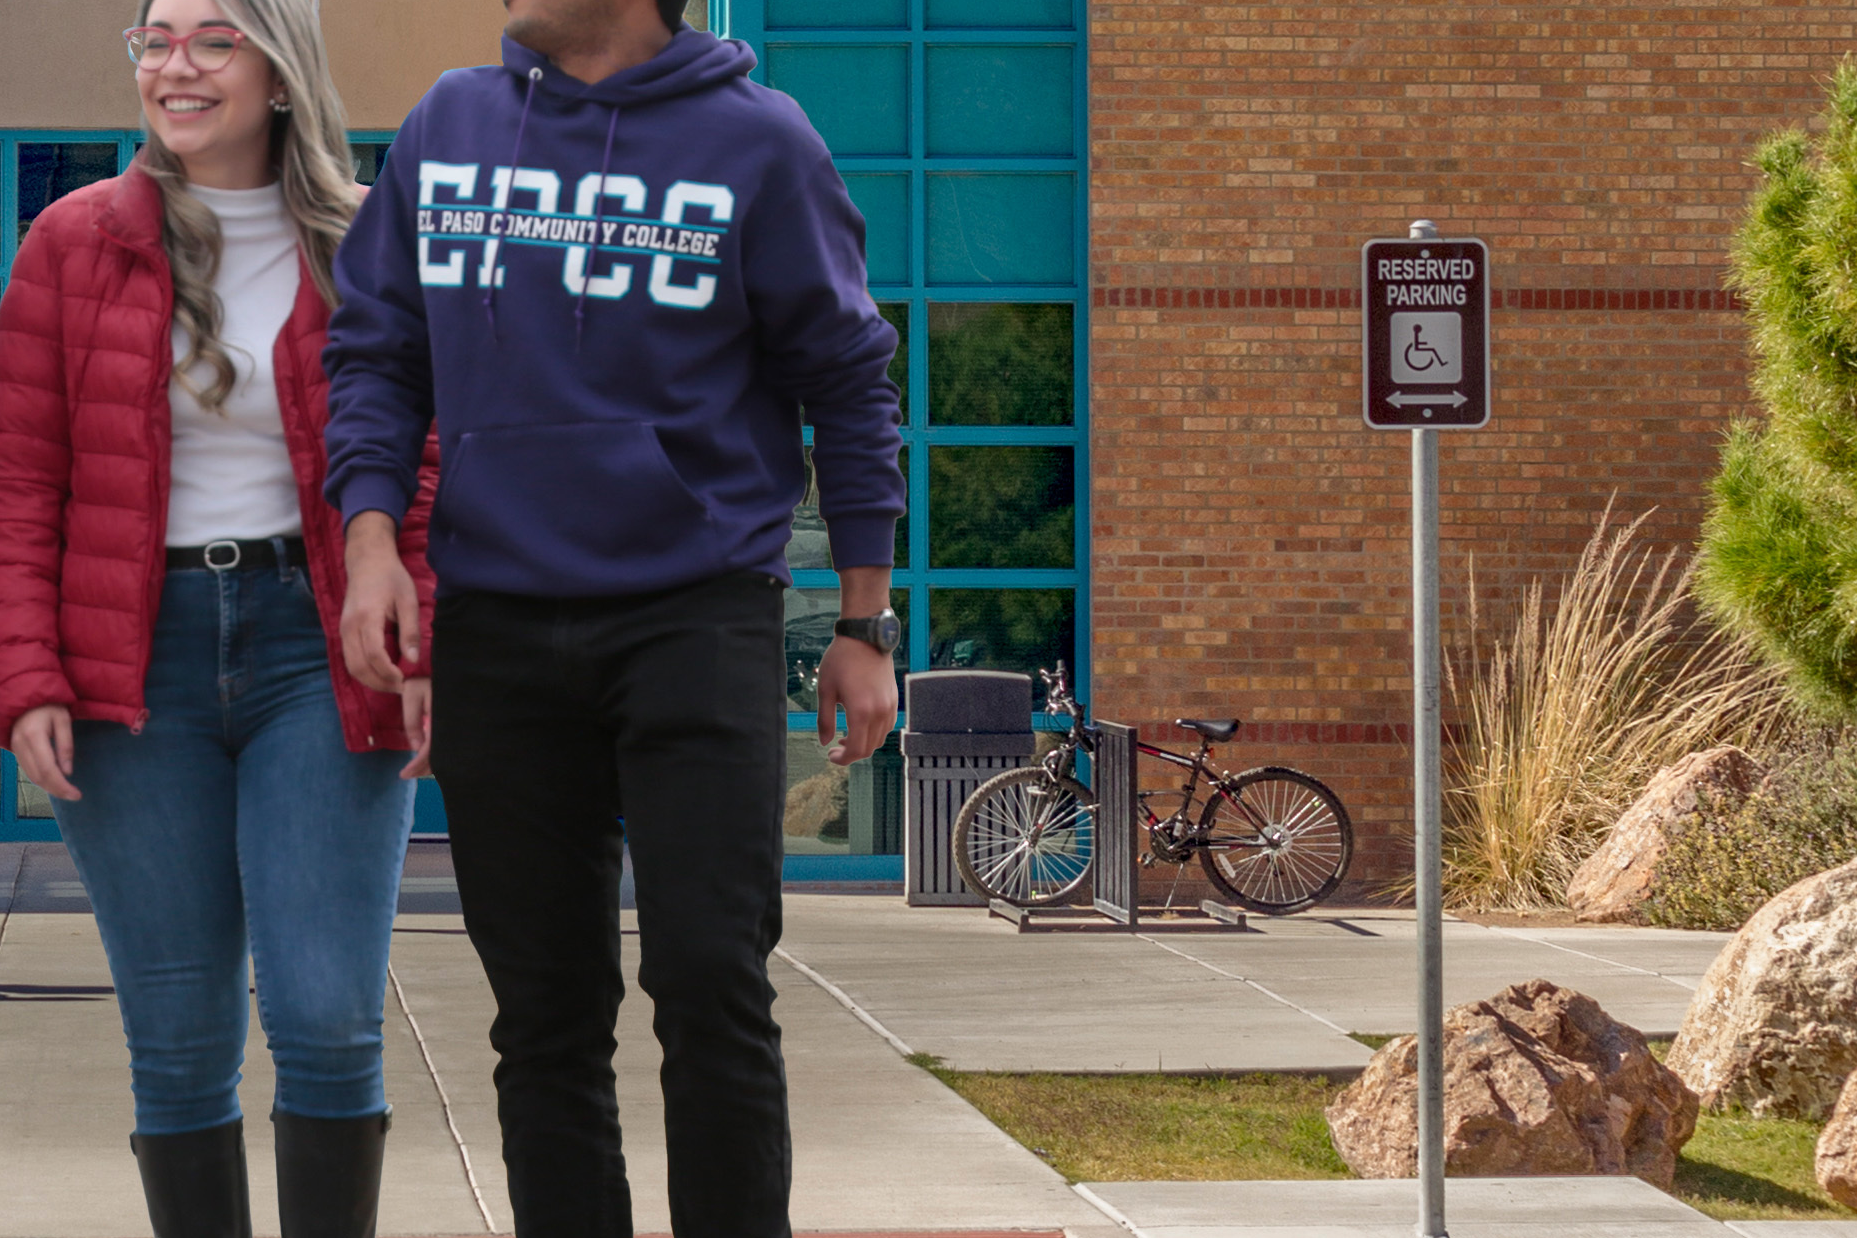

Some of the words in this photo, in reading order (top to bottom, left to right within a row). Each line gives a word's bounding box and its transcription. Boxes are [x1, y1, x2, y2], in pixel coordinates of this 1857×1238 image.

[418, 210, 435, 233] EL
[440, 211, 485, 234] PASO
[622, 224, 719, 257] COLLEGE
[1378, 259, 1474, 280] RESERVED
[1387, 284, 1467, 306] PARKING
